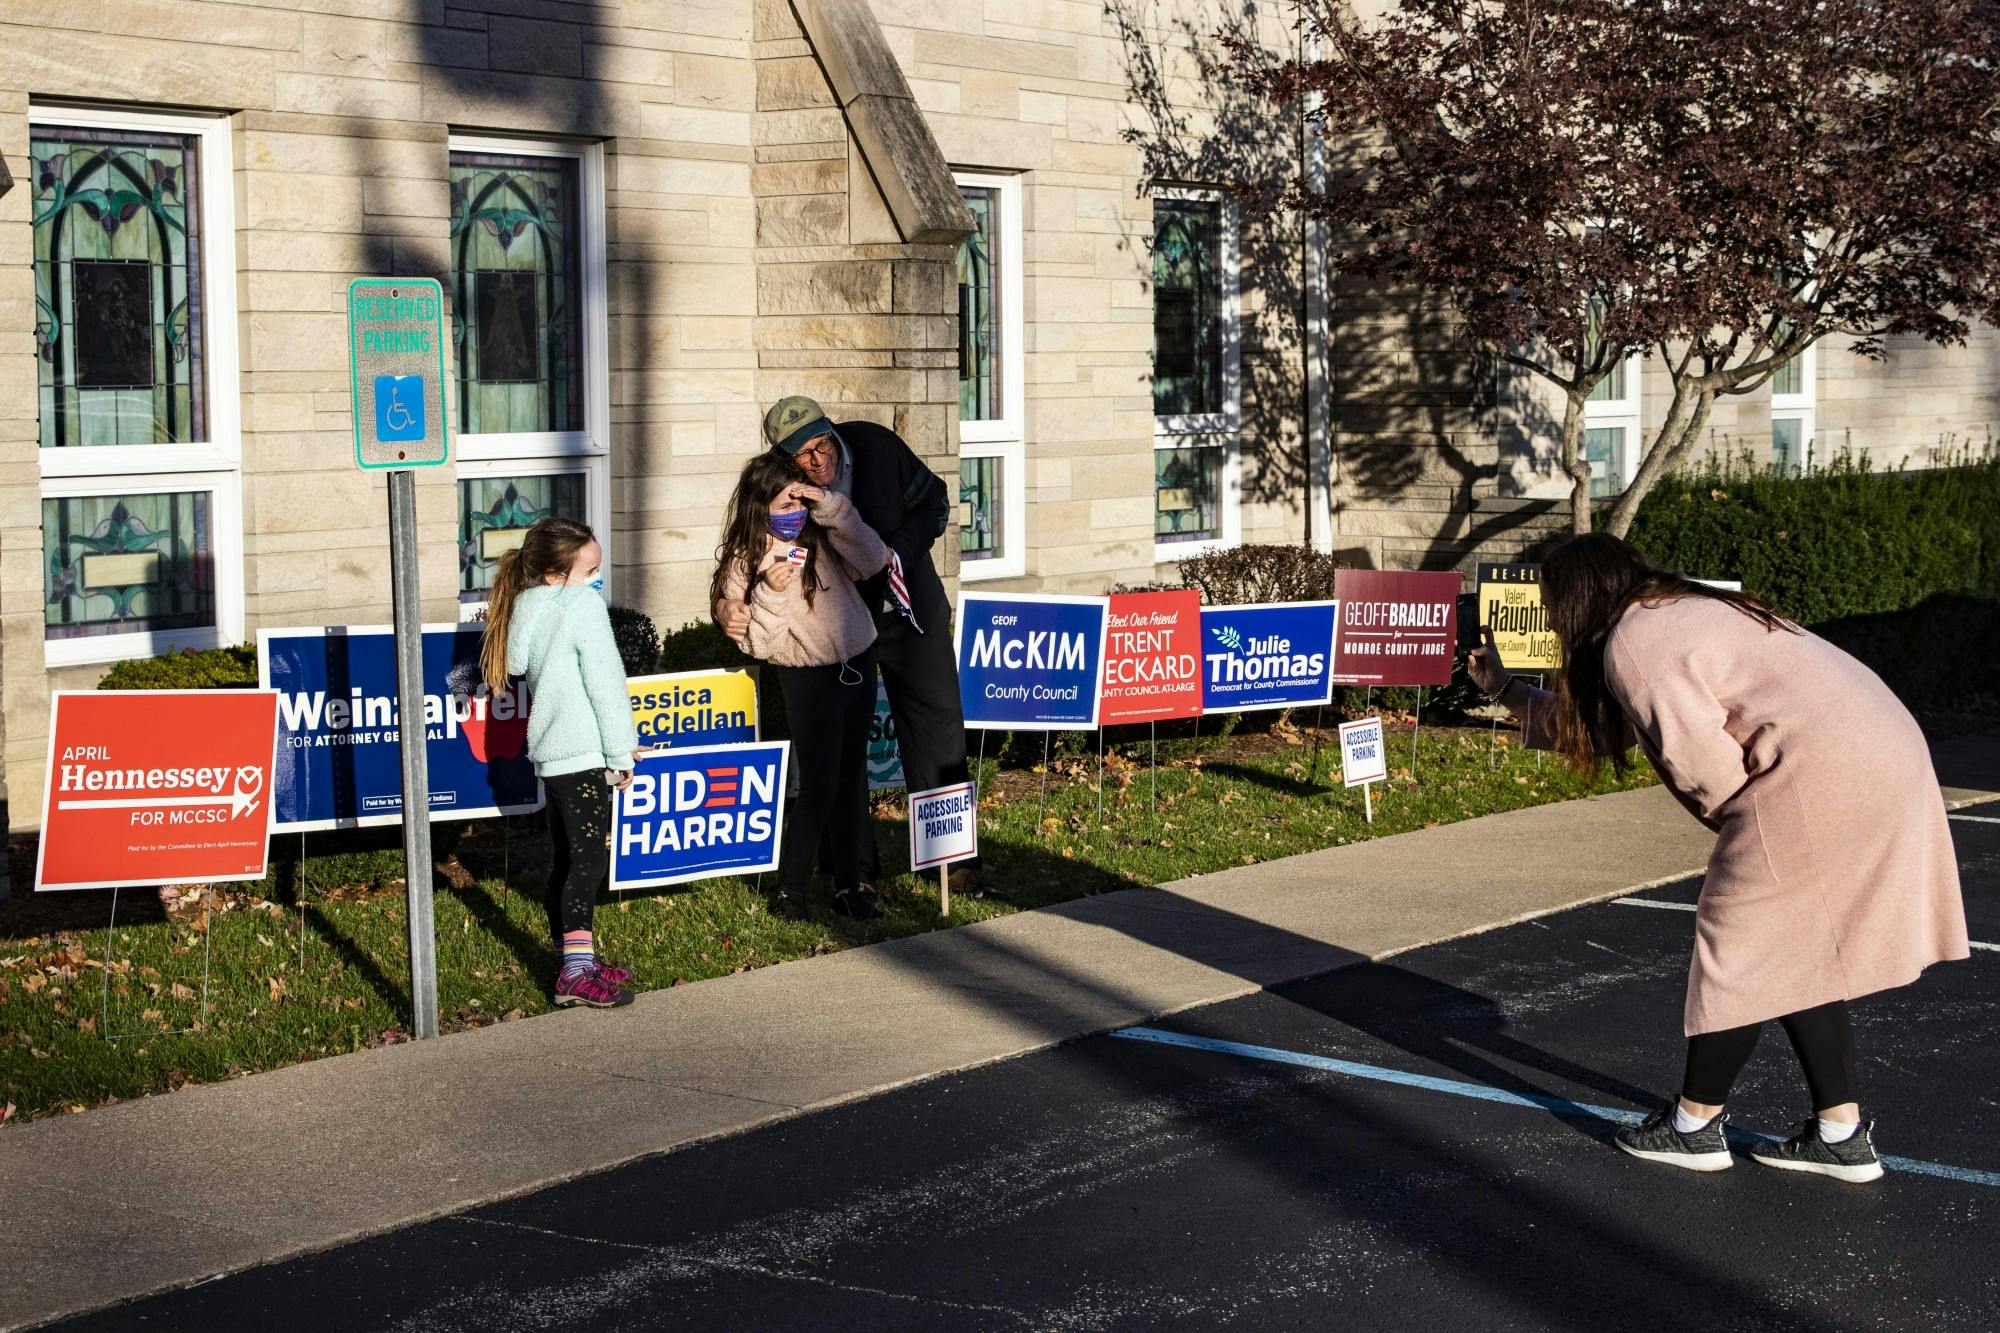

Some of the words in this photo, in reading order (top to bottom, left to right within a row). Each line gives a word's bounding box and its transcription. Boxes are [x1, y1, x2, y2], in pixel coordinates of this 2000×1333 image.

[356, 297, 435, 321] RESERVED
[364, 330, 430, 353] PARKING
[1492, 568, 1535, 581] RE-EL
[1505, 588, 1527, 604] Valeri
[992, 616, 1018, 625] GEOFF
[1130, 612, 1148, 627] Our
[1150, 610, 1178, 625] Friend
[1110, 629, 1174, 654] TRENT
[1246, 635, 1290, 656] Julie
[1394, 631, 1403, 639] for
[969, 629, 1085, 670] McKIM
[1344, 643, 1381, 654] MONROE
[1385, 643, 1418, 655] COUNTY
[1421, 644, 1445, 655] JUDGE
[1105, 655, 1196, 684] ECKARD
[1206, 652, 1324, 682] Thomas
[985, 683, 1030, 702] County
[1032, 685, 1078, 700] Council
[1125, 685, 1160, 696] COUNCIL
[1162, 682, 1195, 692] AT-LARGE
[1211, 684, 1242, 692] Democrat
[1254, 681, 1275, 689] County
[1276, 678, 1319, 687] Commissioner
[630, 686, 712, 711] essica
[278, 681, 528, 738] Weinapfel
[637, 708, 746, 737] cClellan
[287, 737, 311, 748] FOR
[315, 732, 380, 746] ATTORNEY
[384, 729, 443, 743] GEAL
[1346, 728, 1378, 746] ACCESSIBLE
[62, 746, 111, 760] APRIL
[1352, 745, 1376, 761] PARKING
[59, 765, 231, 793] Hennessey
[623, 764, 775, 816] BIDEN
[130, 812, 164, 825] FOR
[169, 809, 227, 824] MCCSC
[918, 795, 969, 821] ACCESSIBLE
[620, 809, 772, 856] HARRIS
[925, 816, 963, 839] PARKING
